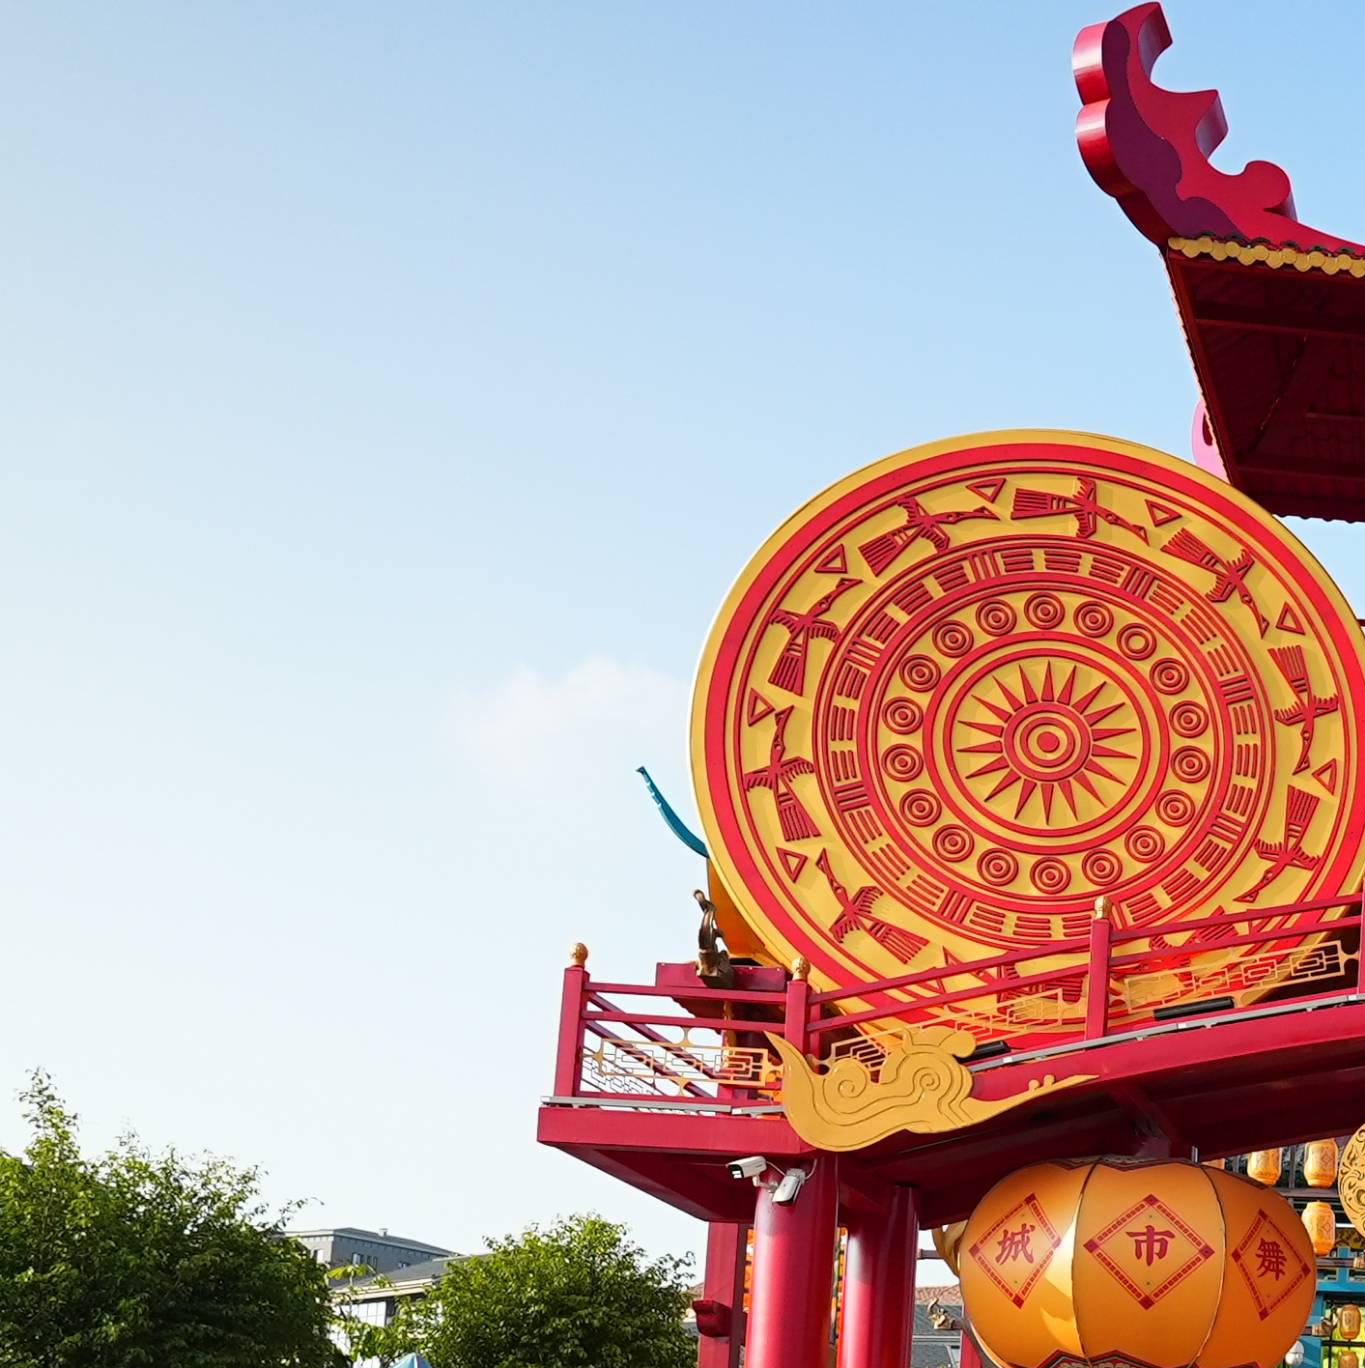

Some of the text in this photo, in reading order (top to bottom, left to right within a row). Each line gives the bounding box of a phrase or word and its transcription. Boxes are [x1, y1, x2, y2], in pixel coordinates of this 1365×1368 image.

[995, 1223, 1288, 1281] 城 市 舞
